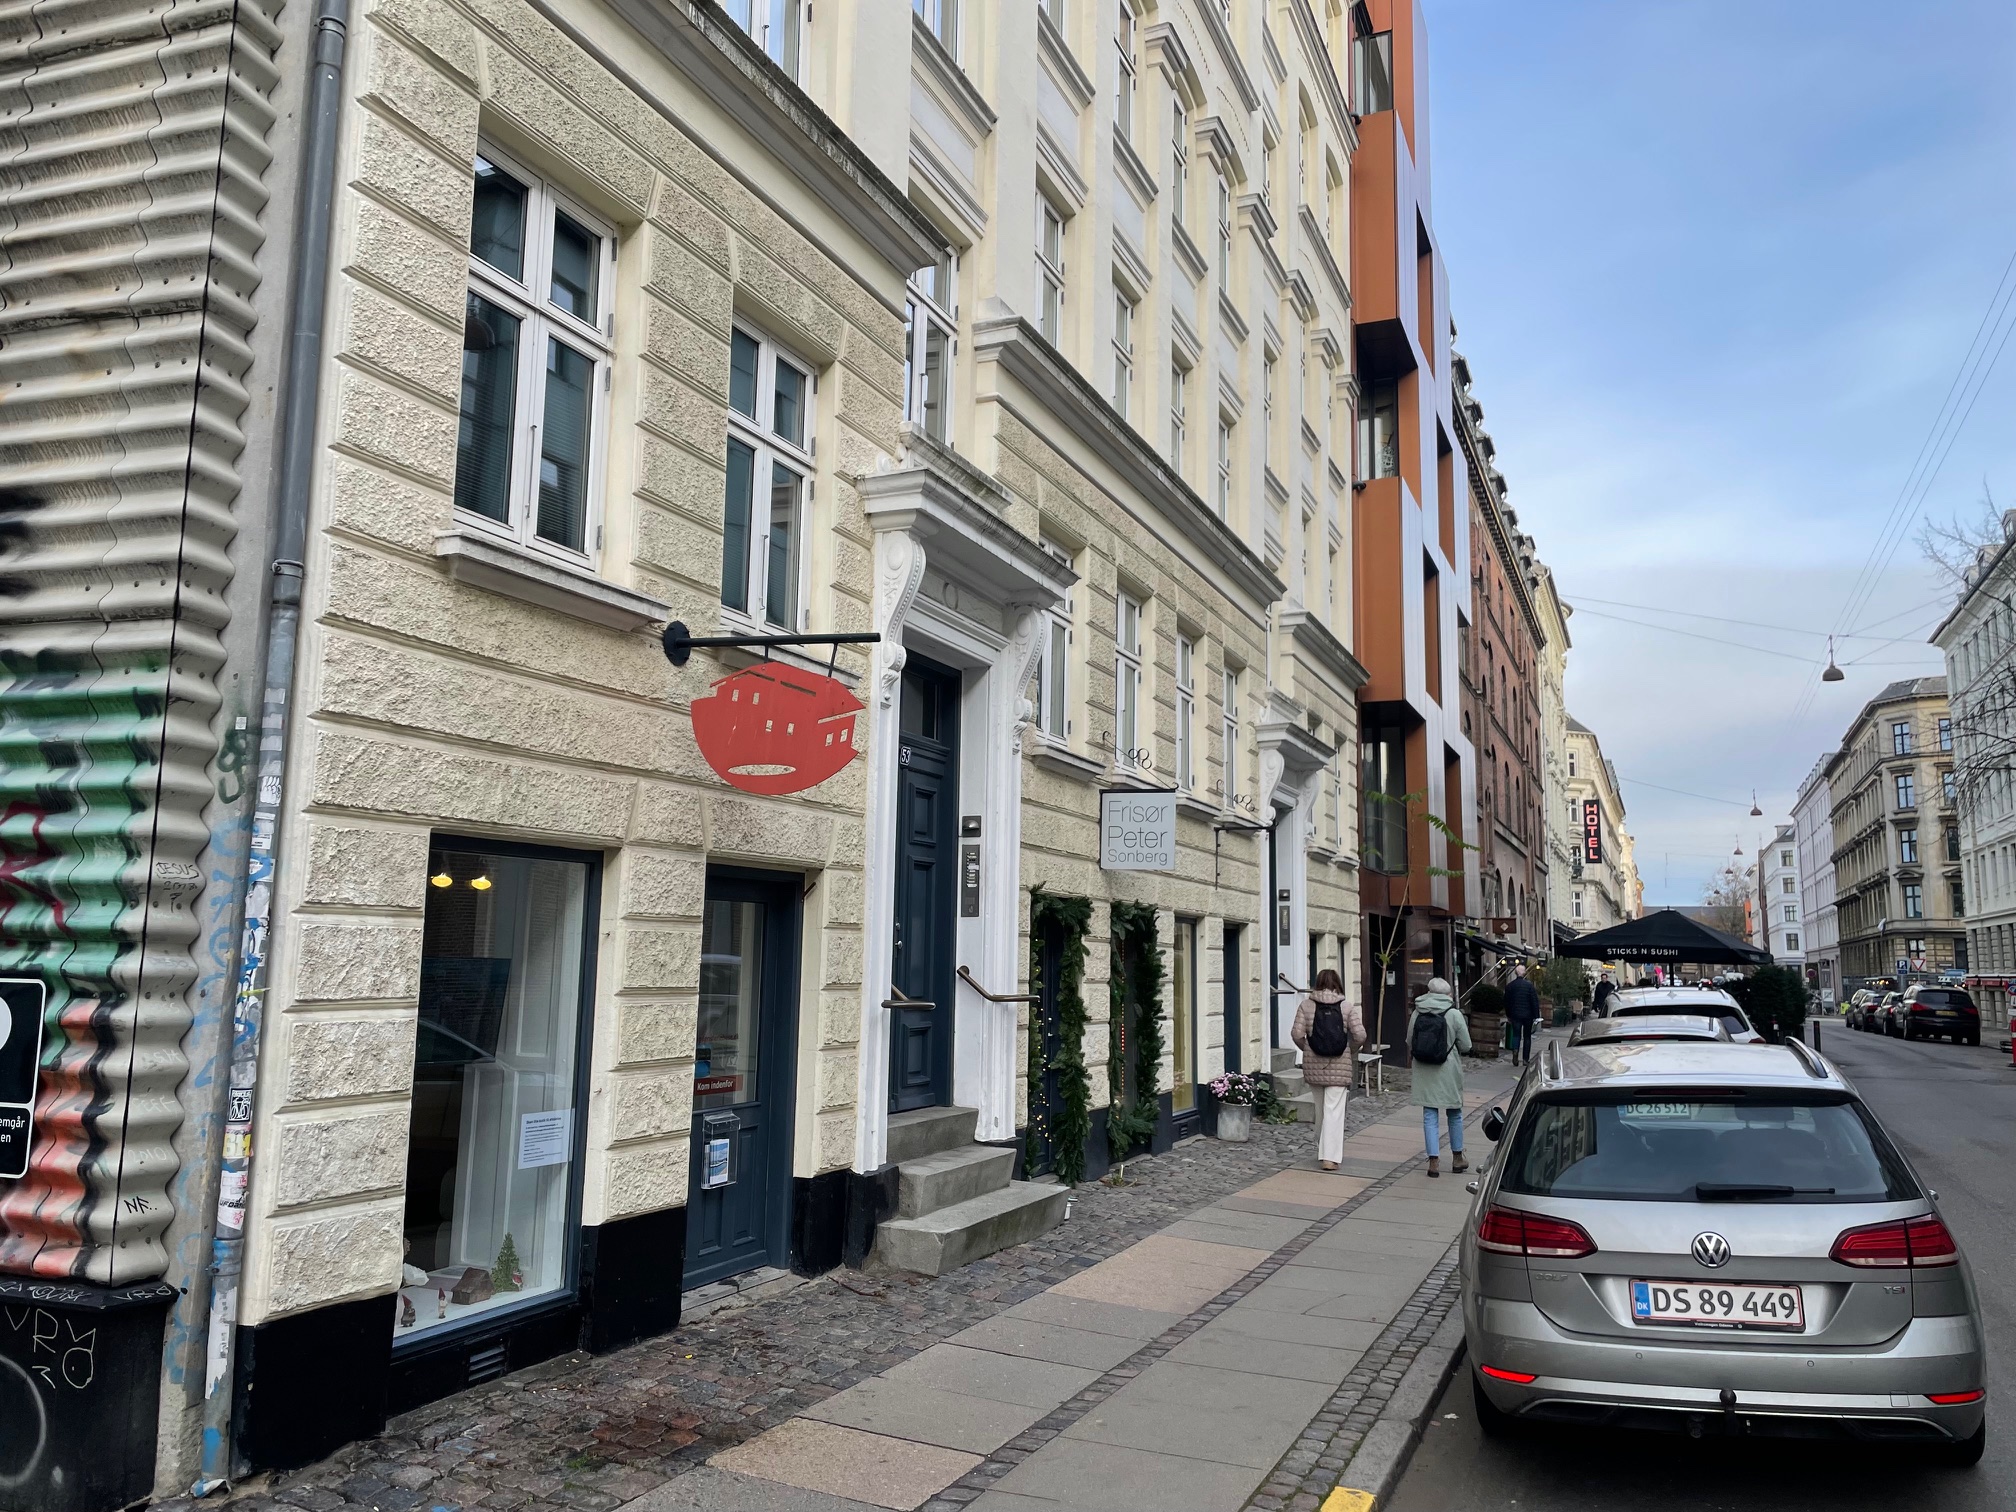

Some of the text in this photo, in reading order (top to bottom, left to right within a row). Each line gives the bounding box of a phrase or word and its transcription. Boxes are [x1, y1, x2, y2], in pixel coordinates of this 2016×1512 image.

[902, 748, 910, 763] 53
[1108, 800, 1168, 823] Frisør
[1108, 825, 1168, 848] Peter
[1586, 804, 1598, 859] HOTEL
[1107, 848, 1168, 866] Sonberg
[1650, 948, 1678, 956] SUSHI
[711, 1080, 734, 1090] indenfor
[1646, 1104, 1661, 1114] 26
[1535, 1273, 1568, 1281] GOLF
[1883, 1286, 1905, 1294] TSI
[1637, 1302, 1648, 1310] DK
[1652, 1287, 1795, 1319] DS 89 449
